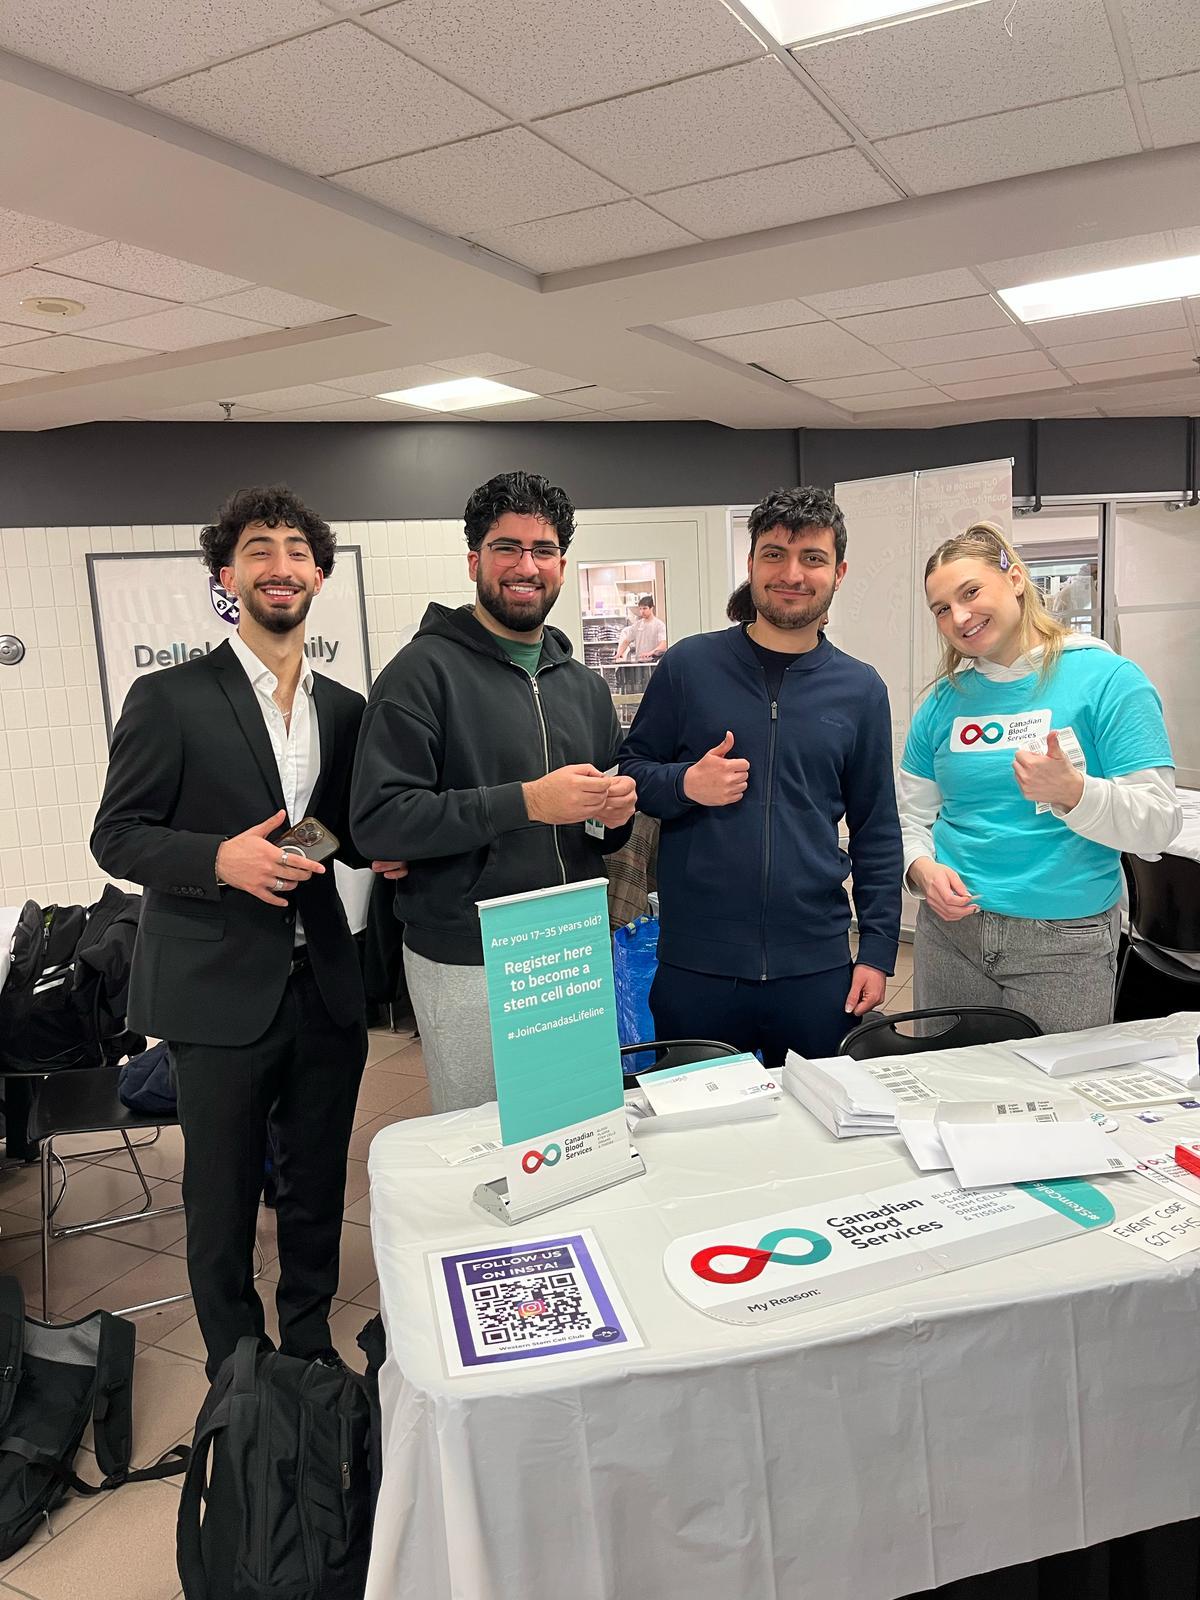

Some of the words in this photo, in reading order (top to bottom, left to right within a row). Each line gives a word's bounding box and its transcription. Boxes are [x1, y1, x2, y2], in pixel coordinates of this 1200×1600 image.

[1008, 726, 1028, 735] Blood
[1009, 718, 1042, 728] Canadian
[1007, 732, 1037, 741] Services
[491, 937, 509, 948] Are
[510, 933, 528, 946] you
[558, 921, 582, 935] years
[583, 915, 602, 927] old?
[504, 952, 561, 975] Register
[563, 945, 592, 960] here
[510, 979, 526, 992] to
[528, 966, 580, 988] become
[582, 963, 590, 974] a
[503, 995, 538, 1013] stem
[540, 985, 563, 1002] cell
[565, 978, 602, 996] donor
[507, 1006, 605, 1040] #JoinCanadasLifeline
[564, 1131, 594, 1146] Canadian
[565, 1141, 584, 1153] Blood
[565, 1146, 593, 1160] Services
[931, 1187, 967, 1200] BLOOD
[940, 1190, 980, 1205] PLASMA
[946, 1198, 976, 1211] STEM
[976, 1191, 1008, 1203] CELLS
[1026, 1181, 1101, 1221] #StemCells
[826, 1199, 925, 1228] Canadian
[954, 1201, 999, 1216] ORGANS
[973, 1204, 1016, 1218] TISSUES
[837, 1216, 903, 1239] Blood
[850, 1219, 944, 1250] Services
[1113, 1216, 1157, 1238] EVENT
[1144, 1231, 1177, 1247] 627
[472, 1254, 537, 1271] FOLLOW
[541, 1250, 562, 1259] US
[482, 1270, 506, 1280] ON
[509, 1261, 559, 1275] INSTA!
[746, 1303, 768, 1313] My
[768, 1289, 821, 1307] Reason:
[498, 1343, 531, 1351] Western
[532, 1339, 552, 1347] Stem
